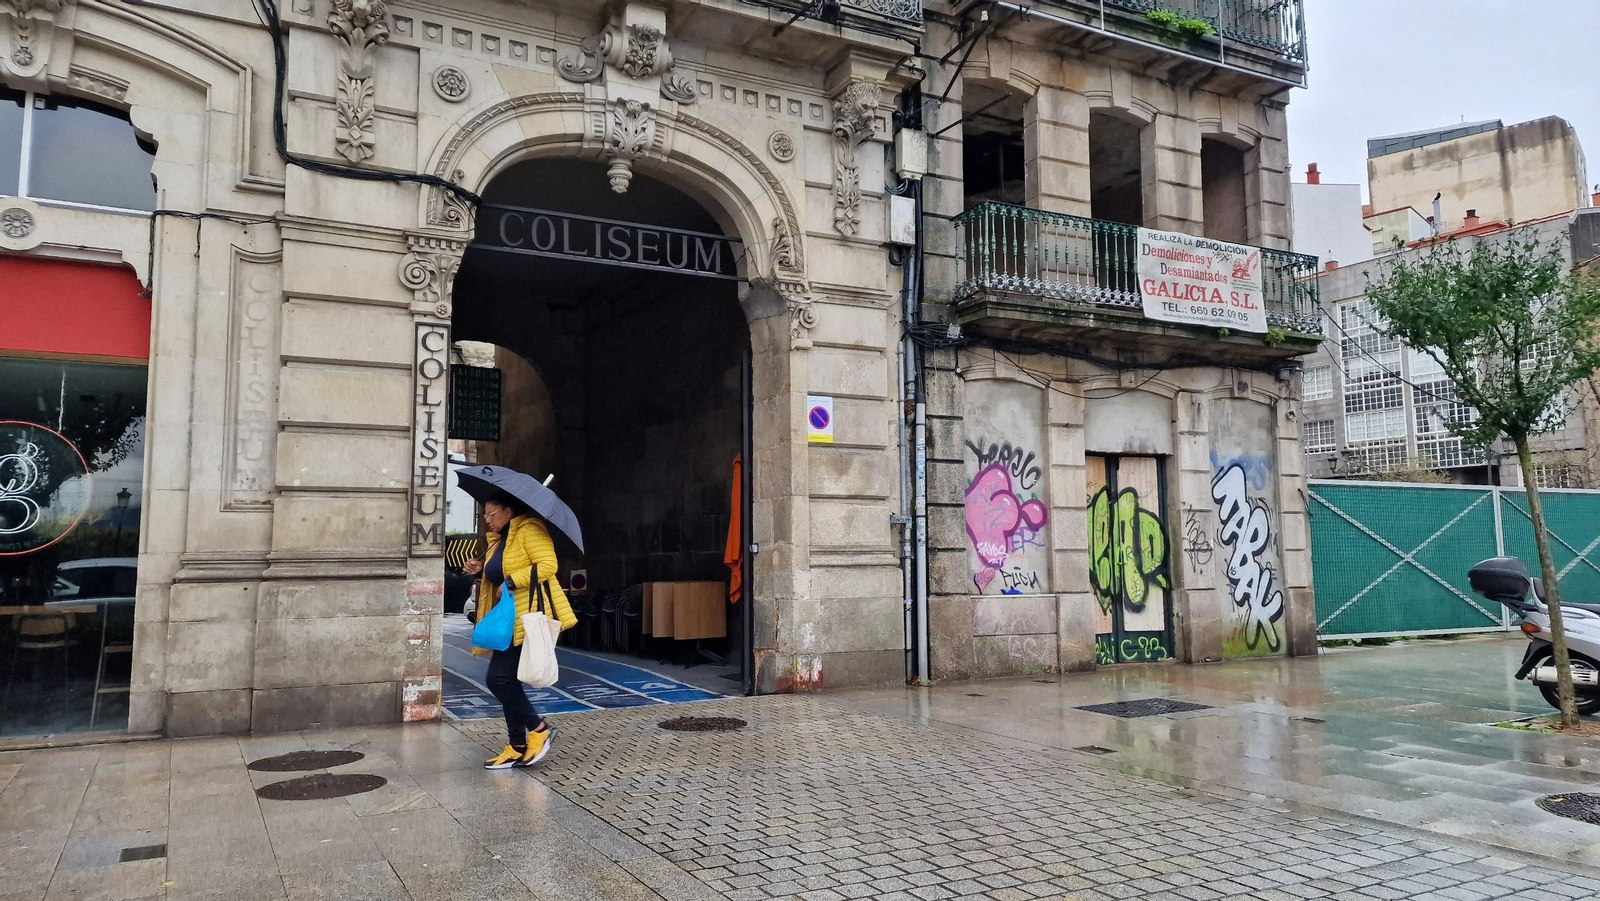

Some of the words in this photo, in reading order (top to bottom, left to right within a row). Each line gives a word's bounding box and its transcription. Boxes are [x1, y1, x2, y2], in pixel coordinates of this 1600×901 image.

[499, 212, 722, 274] COLISEUM
[1147, 232, 1182, 244] REALIZA
[1184, 237, 1193, 247] LA
[1141, 243, 1205, 265] Demoliciones
[1206, 256, 1213, 269] y
[1160, 262, 1228, 284] Desamiantados
[1143, 278, 1229, 307] GALICIA,
[1230, 291, 1259, 310] S.L.
[1161, 302, 1188, 314] TEL.:
[1190, 305, 1208, 316] 660
[1211, 307, 1224, 317] 62
[1238, 311, 1249, 321] 05
[411, 331, 445, 546] COLISEUM
